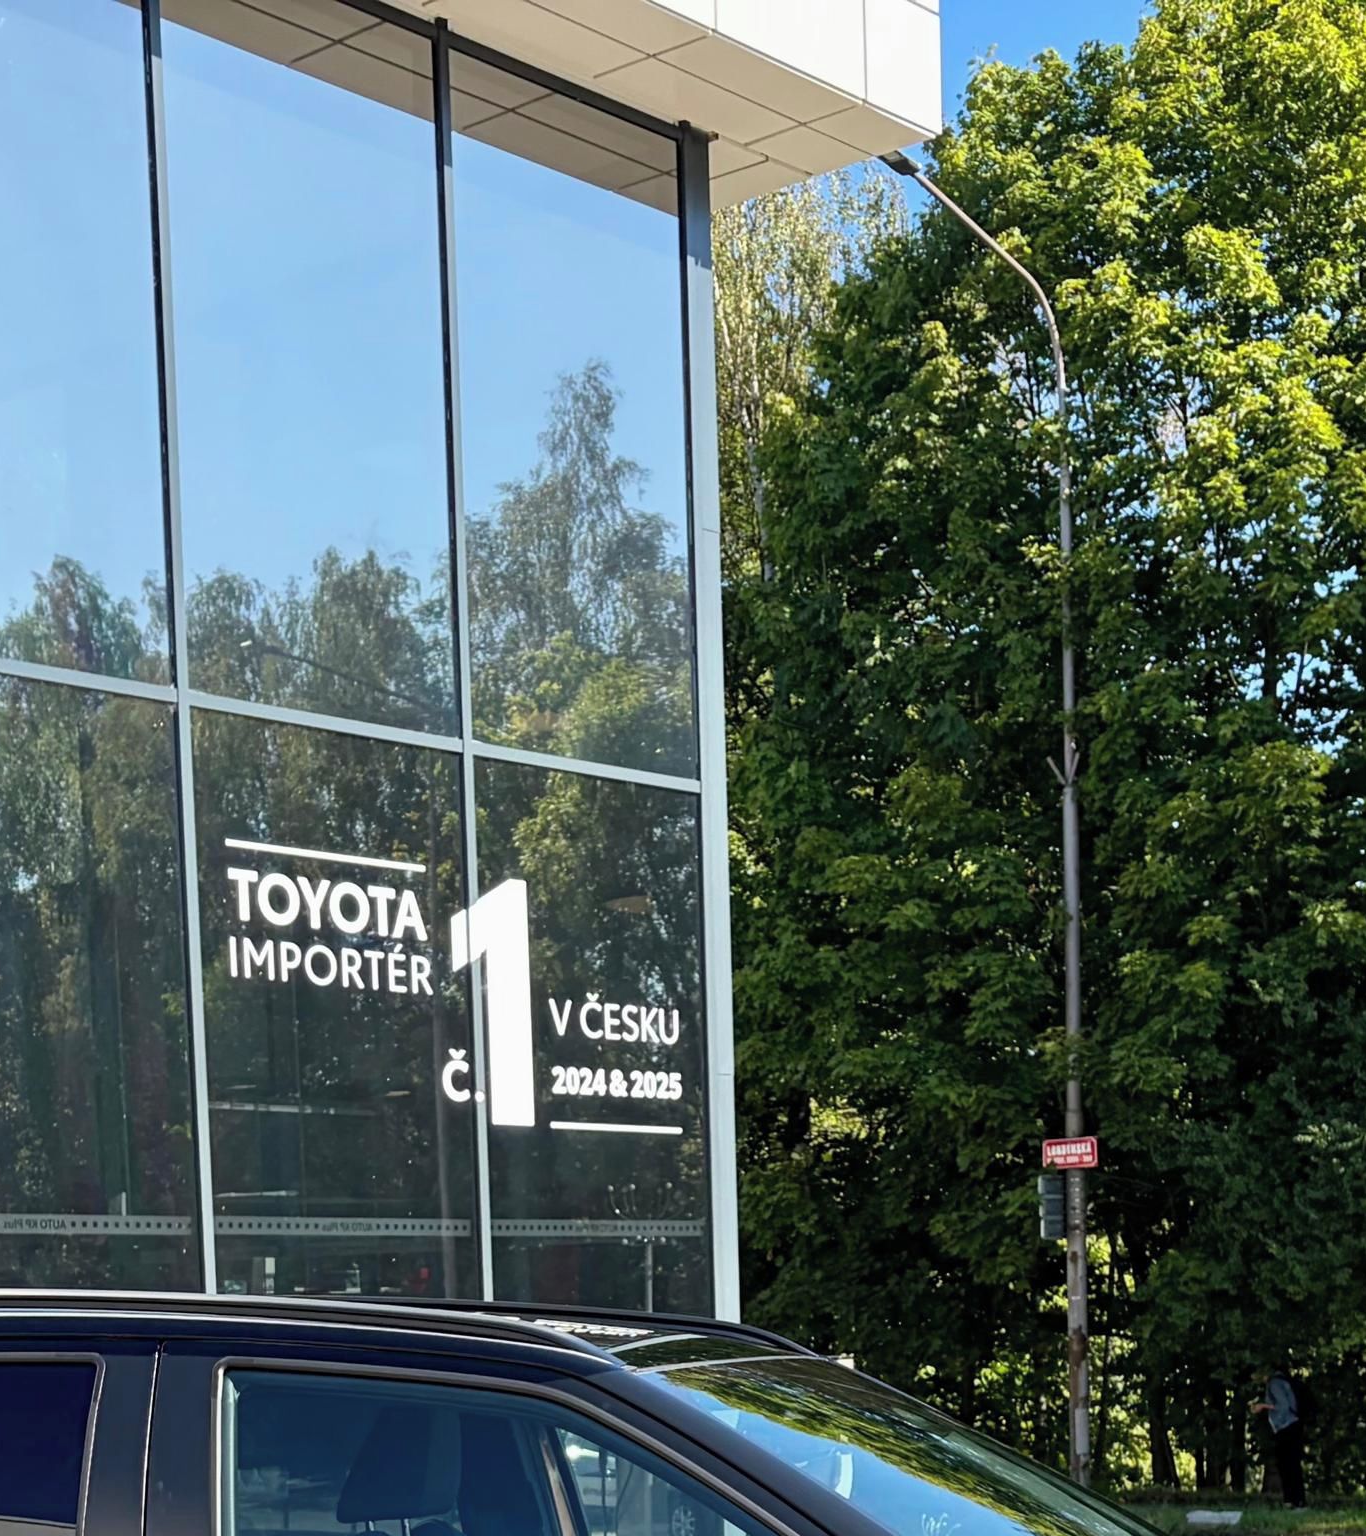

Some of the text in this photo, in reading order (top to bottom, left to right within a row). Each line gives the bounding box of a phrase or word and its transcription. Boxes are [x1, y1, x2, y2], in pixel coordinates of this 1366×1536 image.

[227, 867, 429, 942] TOYOTA
[229, 936, 434, 996] IMPORTÉR
[450, 878, 536, 1128] 1
[548, 992, 681, 1046] V ČESKU
[551, 1066, 607, 1097] 2024
[630, 1070, 683, 1100] 2025
